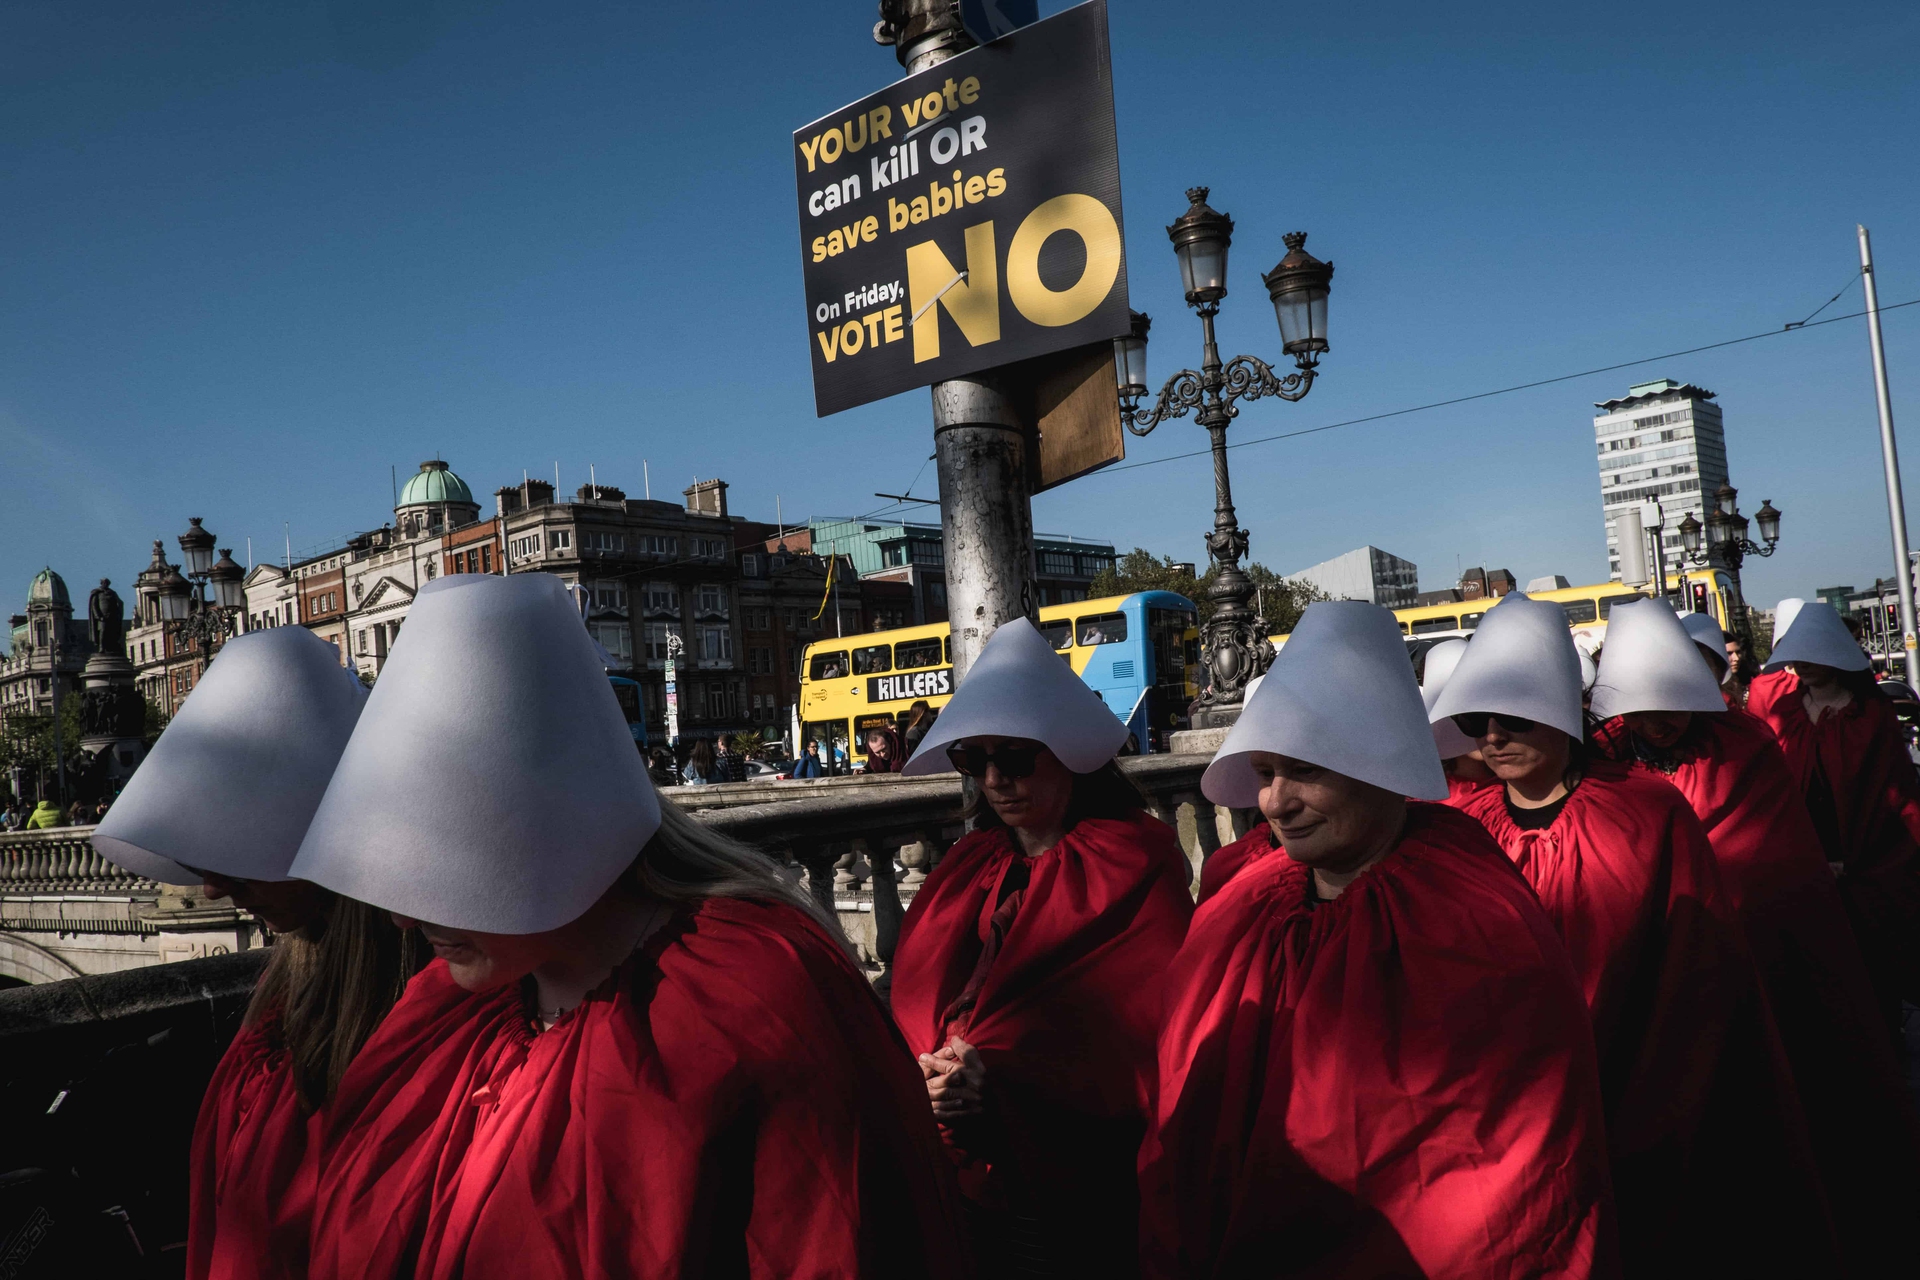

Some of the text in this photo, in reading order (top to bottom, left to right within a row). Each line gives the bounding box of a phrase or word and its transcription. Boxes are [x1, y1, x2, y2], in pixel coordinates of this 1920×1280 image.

[799, 76, 980, 173] YOUR vote
[808, 115, 988, 217] can kill OR
[812, 168, 1007, 263] save babies
[816, 279, 905, 323] On Friday,
[817, 193, 1121, 365] VOTE NO
[878, 670, 949, 700] KILLERS
